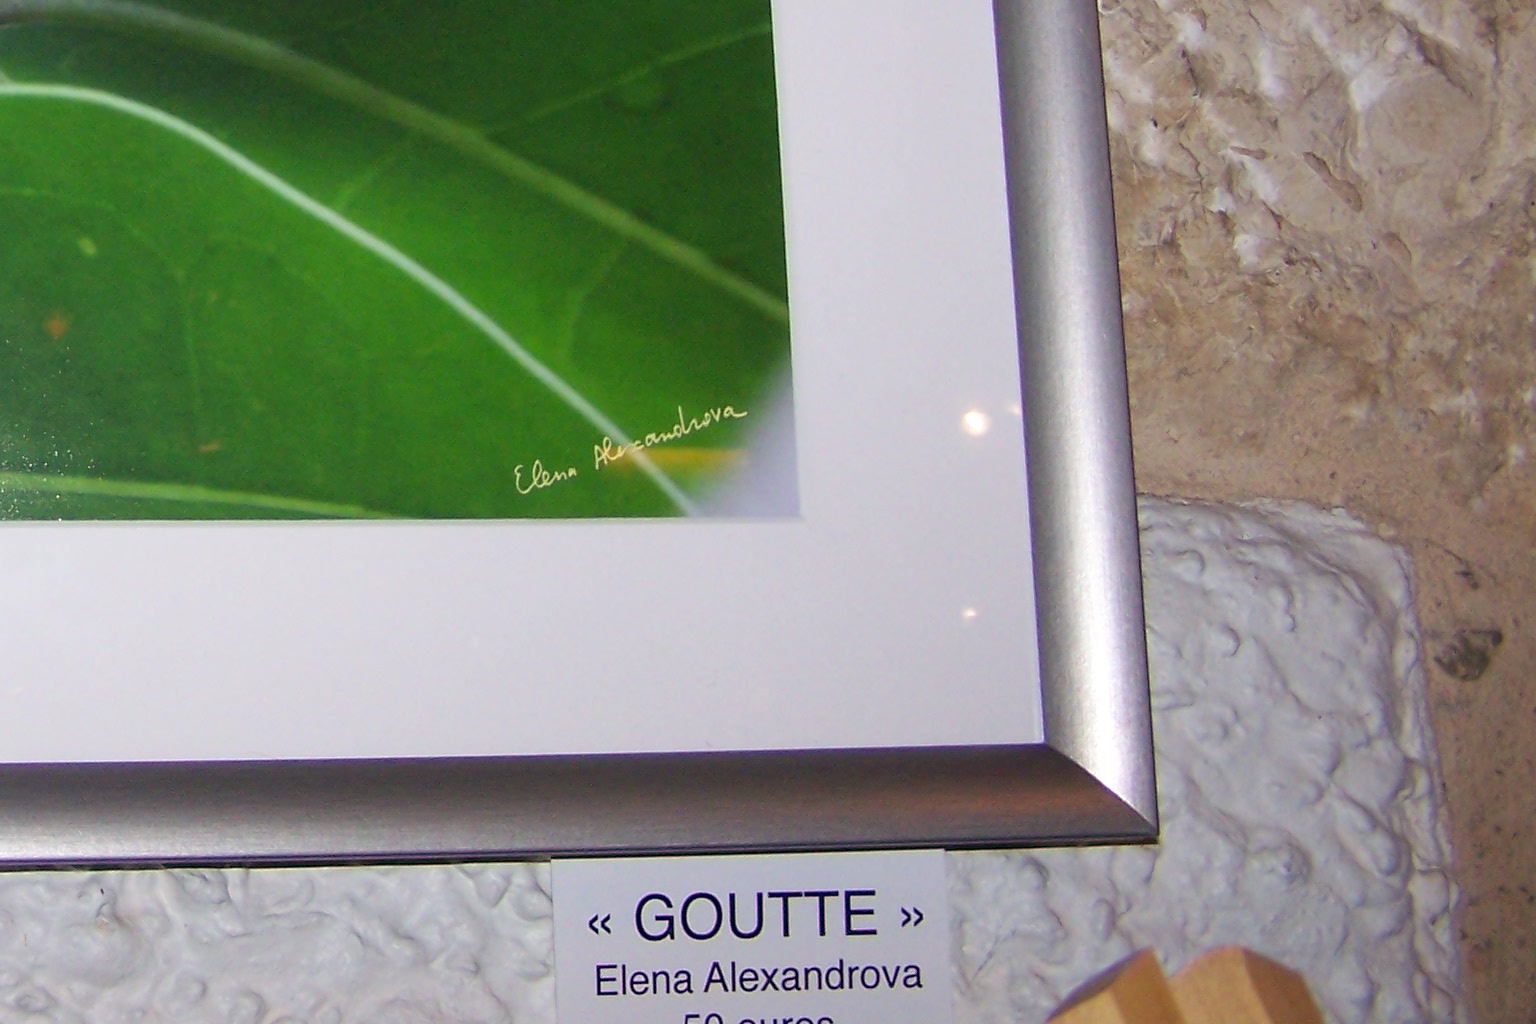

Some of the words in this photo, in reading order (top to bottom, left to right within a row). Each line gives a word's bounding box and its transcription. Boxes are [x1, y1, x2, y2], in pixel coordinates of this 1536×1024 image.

[513, 459, 578, 494] Elena
[593, 405, 748, 470] Alexandrova
[634, 889, 878, 942] GOUTTE
[595, 963, 694, 996] Elena
[704, 958, 924, 993] Alexandrova
